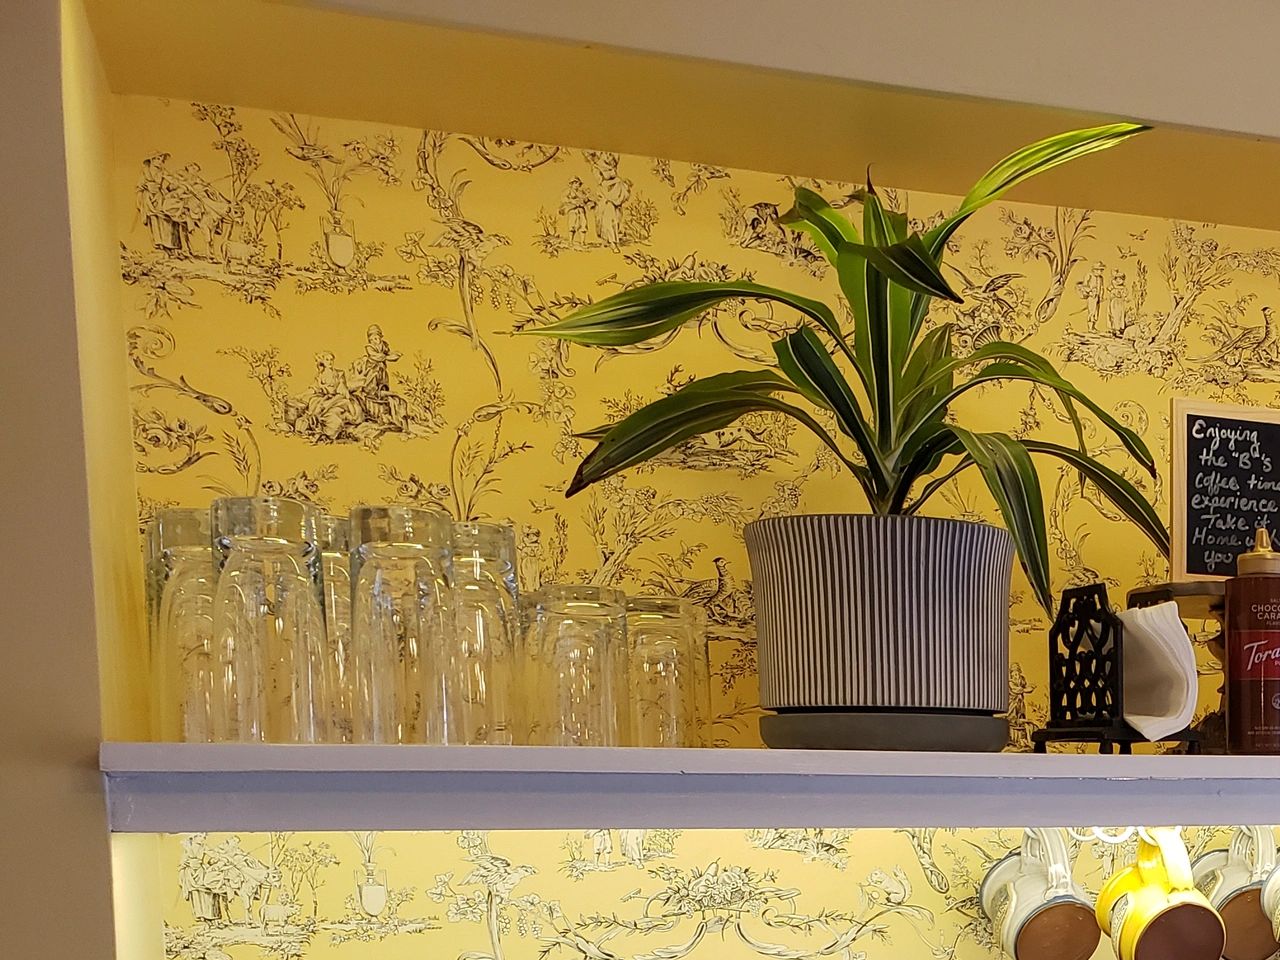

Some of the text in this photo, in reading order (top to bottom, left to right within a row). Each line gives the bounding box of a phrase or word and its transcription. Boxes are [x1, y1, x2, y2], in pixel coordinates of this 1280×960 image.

[1192, 419, 1260, 457] Enjoying
[1199, 448, 1228, 467] the
[1201, 514, 1270, 530] Take it
[1204, 551, 1233, 572] you
